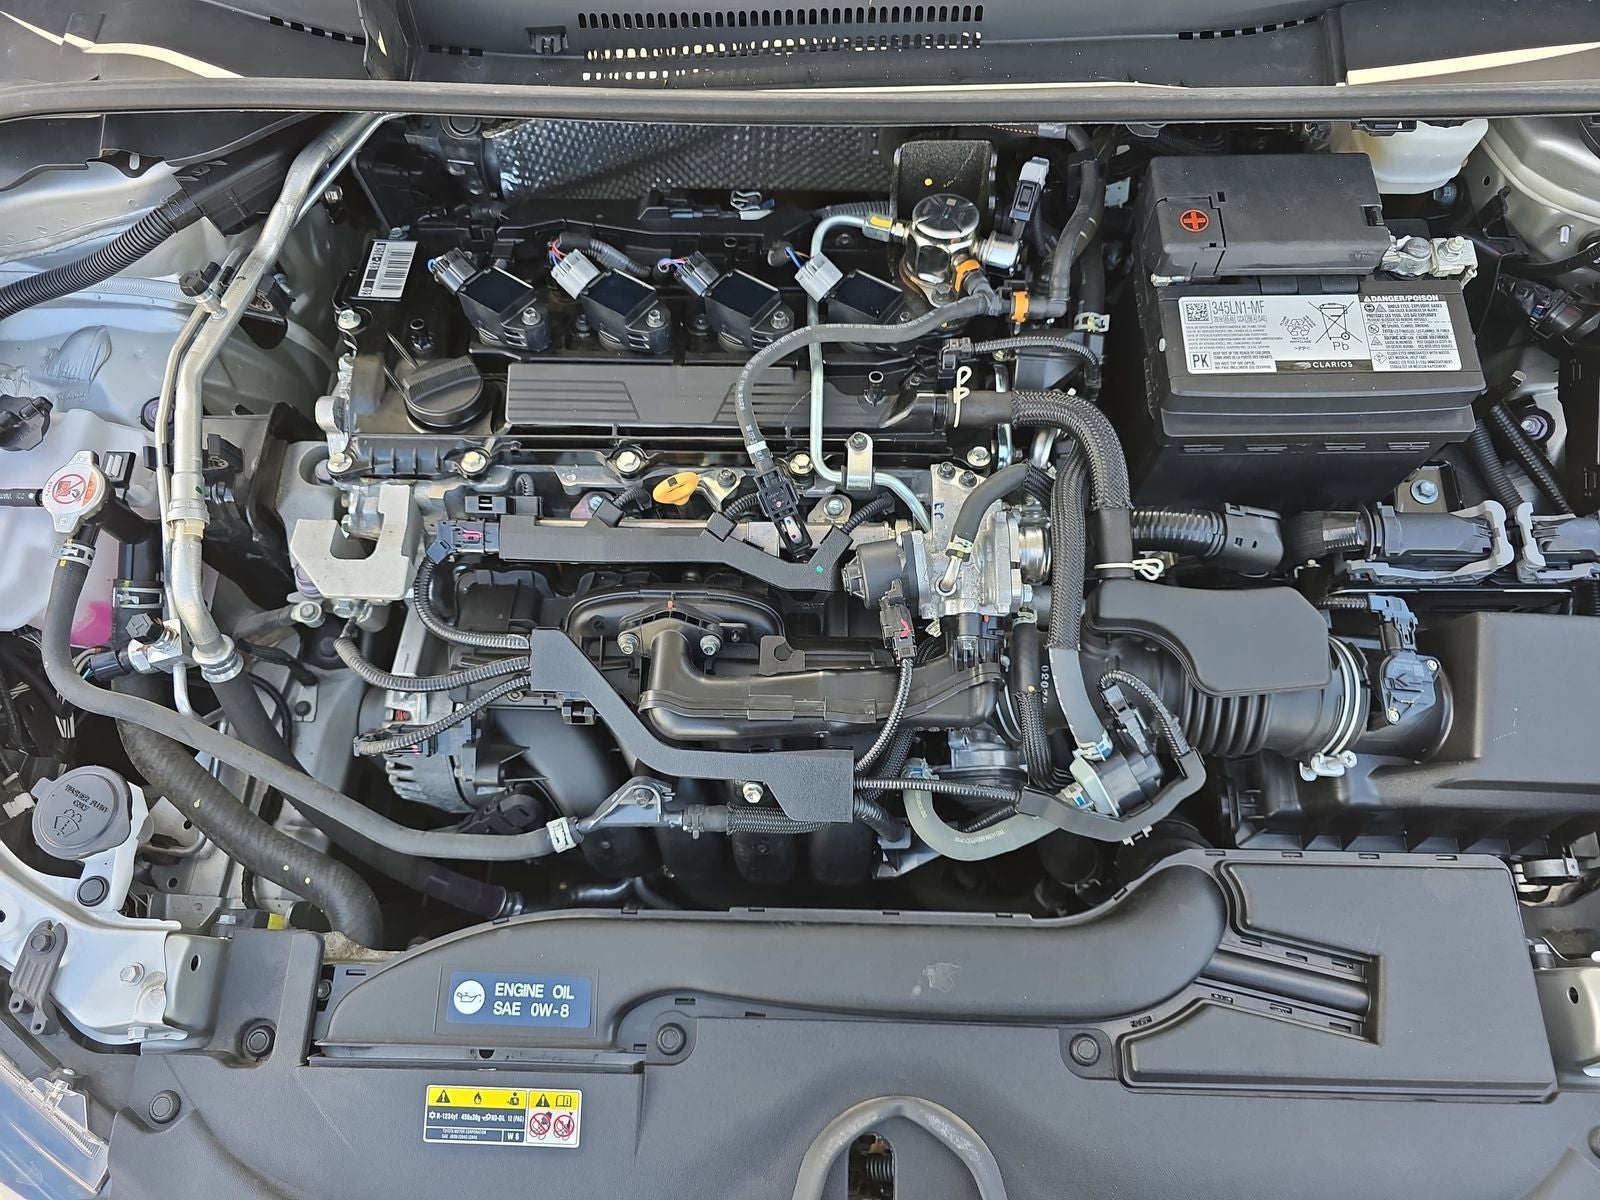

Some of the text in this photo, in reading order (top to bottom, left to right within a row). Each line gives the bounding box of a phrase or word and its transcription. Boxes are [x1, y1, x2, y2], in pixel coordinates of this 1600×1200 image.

[1212, 300, 1264, 314] 345LN1-MF
[1333, 342, 1349, 350] Pb
[1192, 354, 1209, 368] PK
[494, 982, 575, 1000] ENGINE OIL
[493, 1001, 570, 1018] SAE 0W-8
